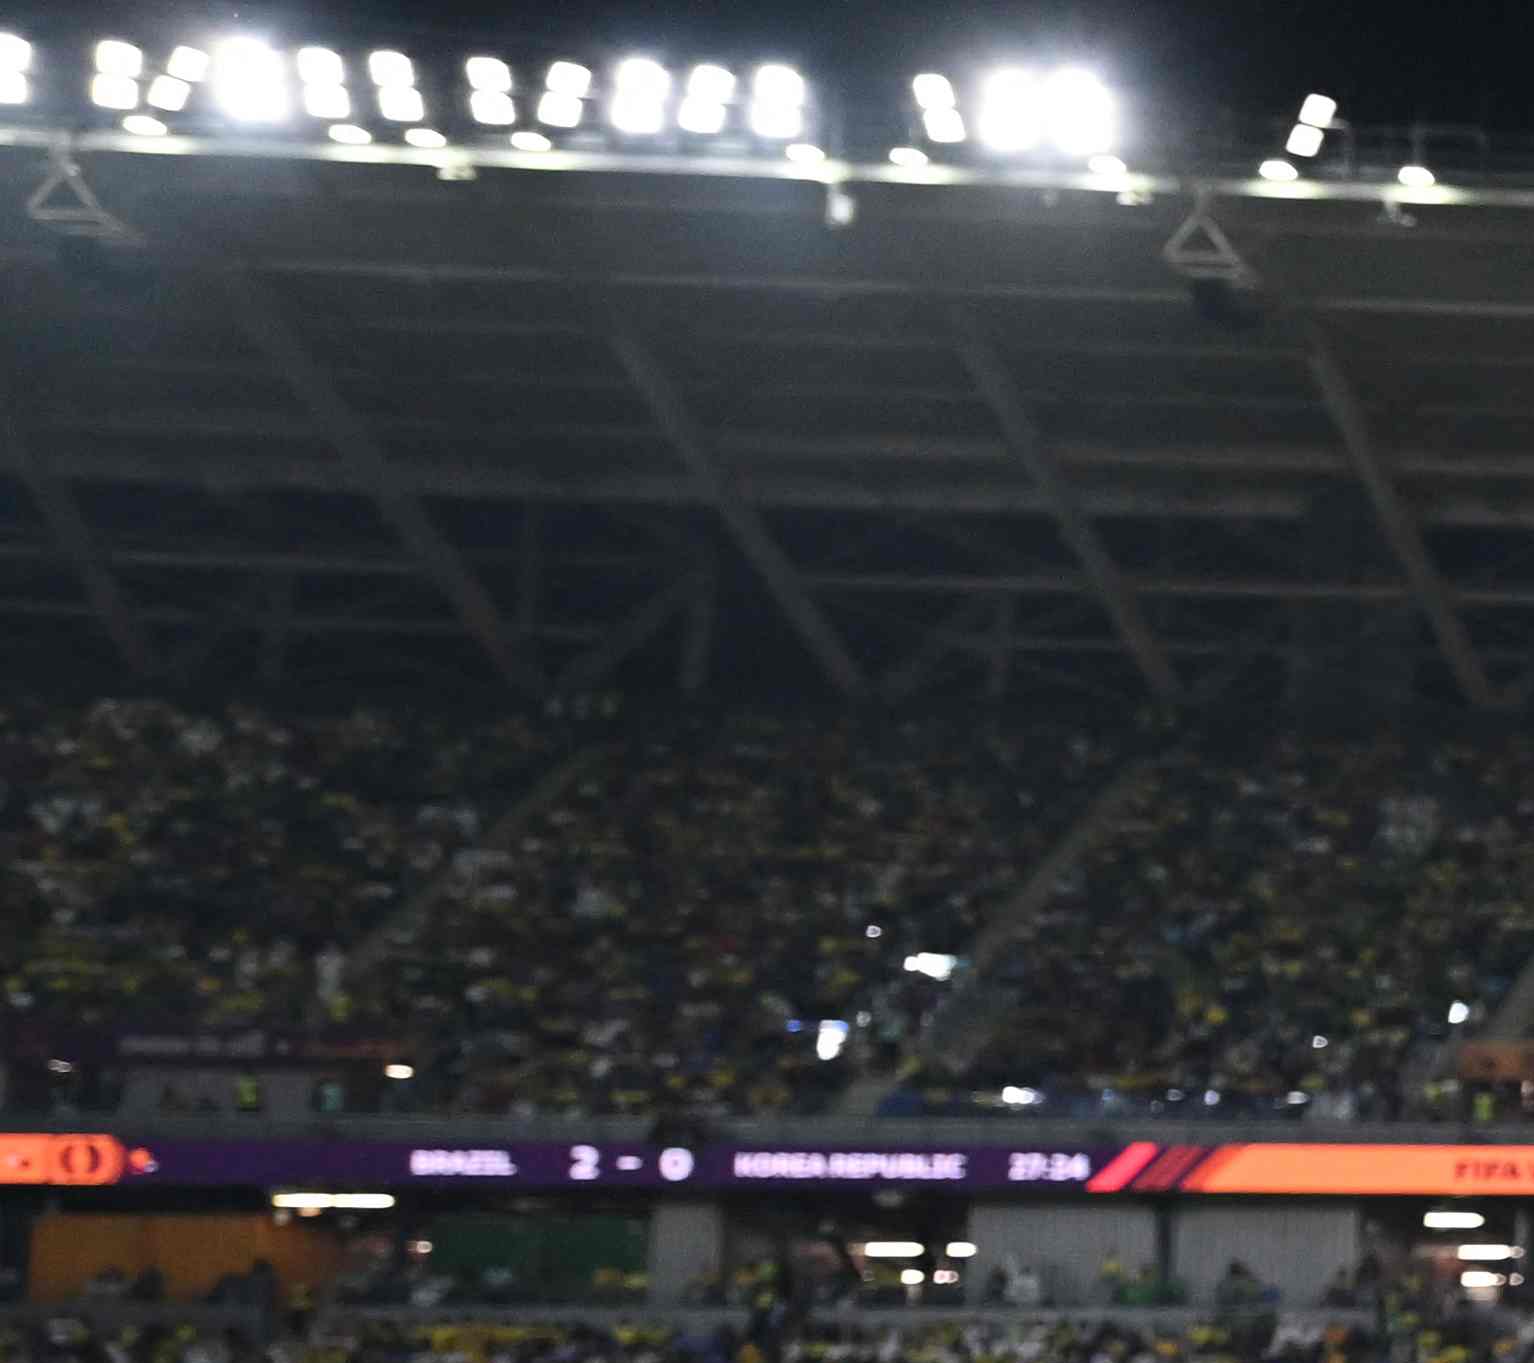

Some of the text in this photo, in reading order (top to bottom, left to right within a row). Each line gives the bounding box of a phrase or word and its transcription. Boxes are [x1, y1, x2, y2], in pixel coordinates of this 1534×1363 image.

[569, 1145, 600, 1180] 2
[658, 1147, 695, 1181] 0
[733, 1152, 825, 1179] KOREA
[828, 1152, 967, 1181] REPUBLIC
[1453, 1161, 1520, 1181] FIFA
